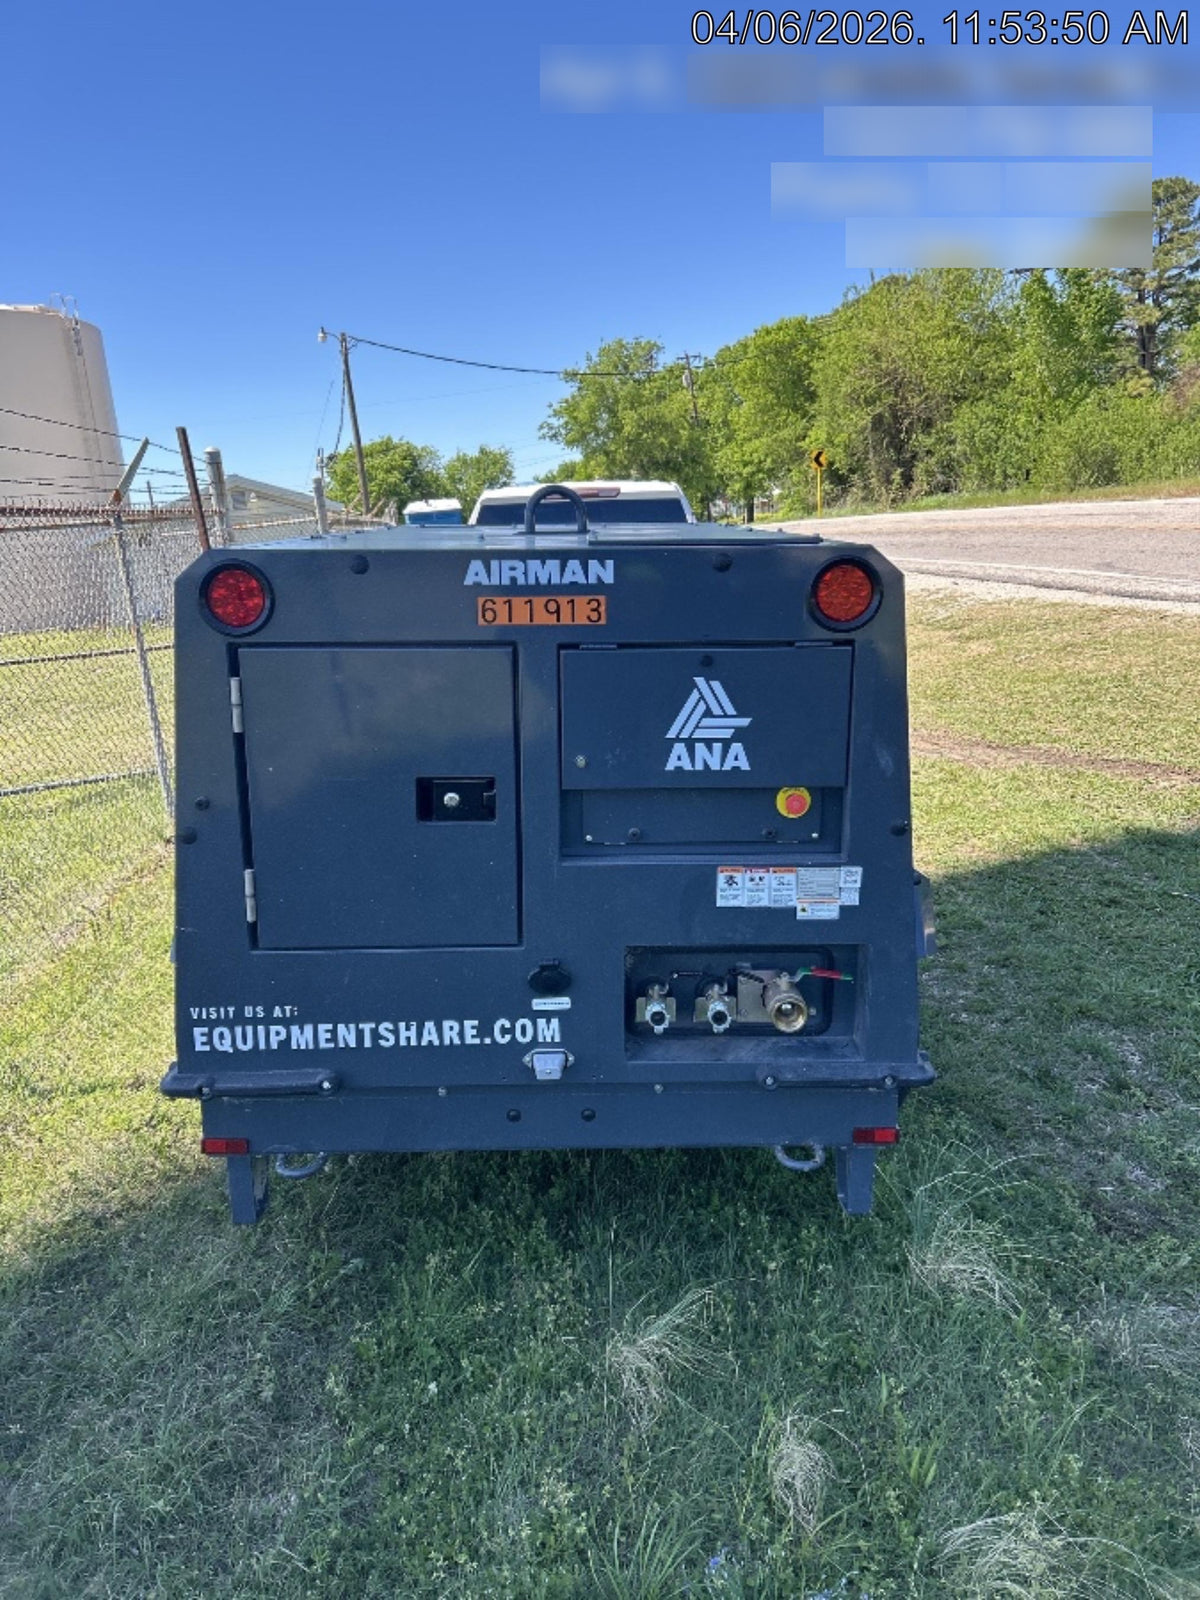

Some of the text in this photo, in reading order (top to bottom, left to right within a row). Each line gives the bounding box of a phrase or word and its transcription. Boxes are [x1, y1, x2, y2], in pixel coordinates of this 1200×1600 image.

[464, 559, 615, 586] AIRMAN
[480, 598, 603, 624] 611913
[664, 742, 751, 771] ANA
[189, 1004, 299, 1021] VISIT US AT:
[192, 1017, 562, 1053] EQUIPMENTSHARE.COM
